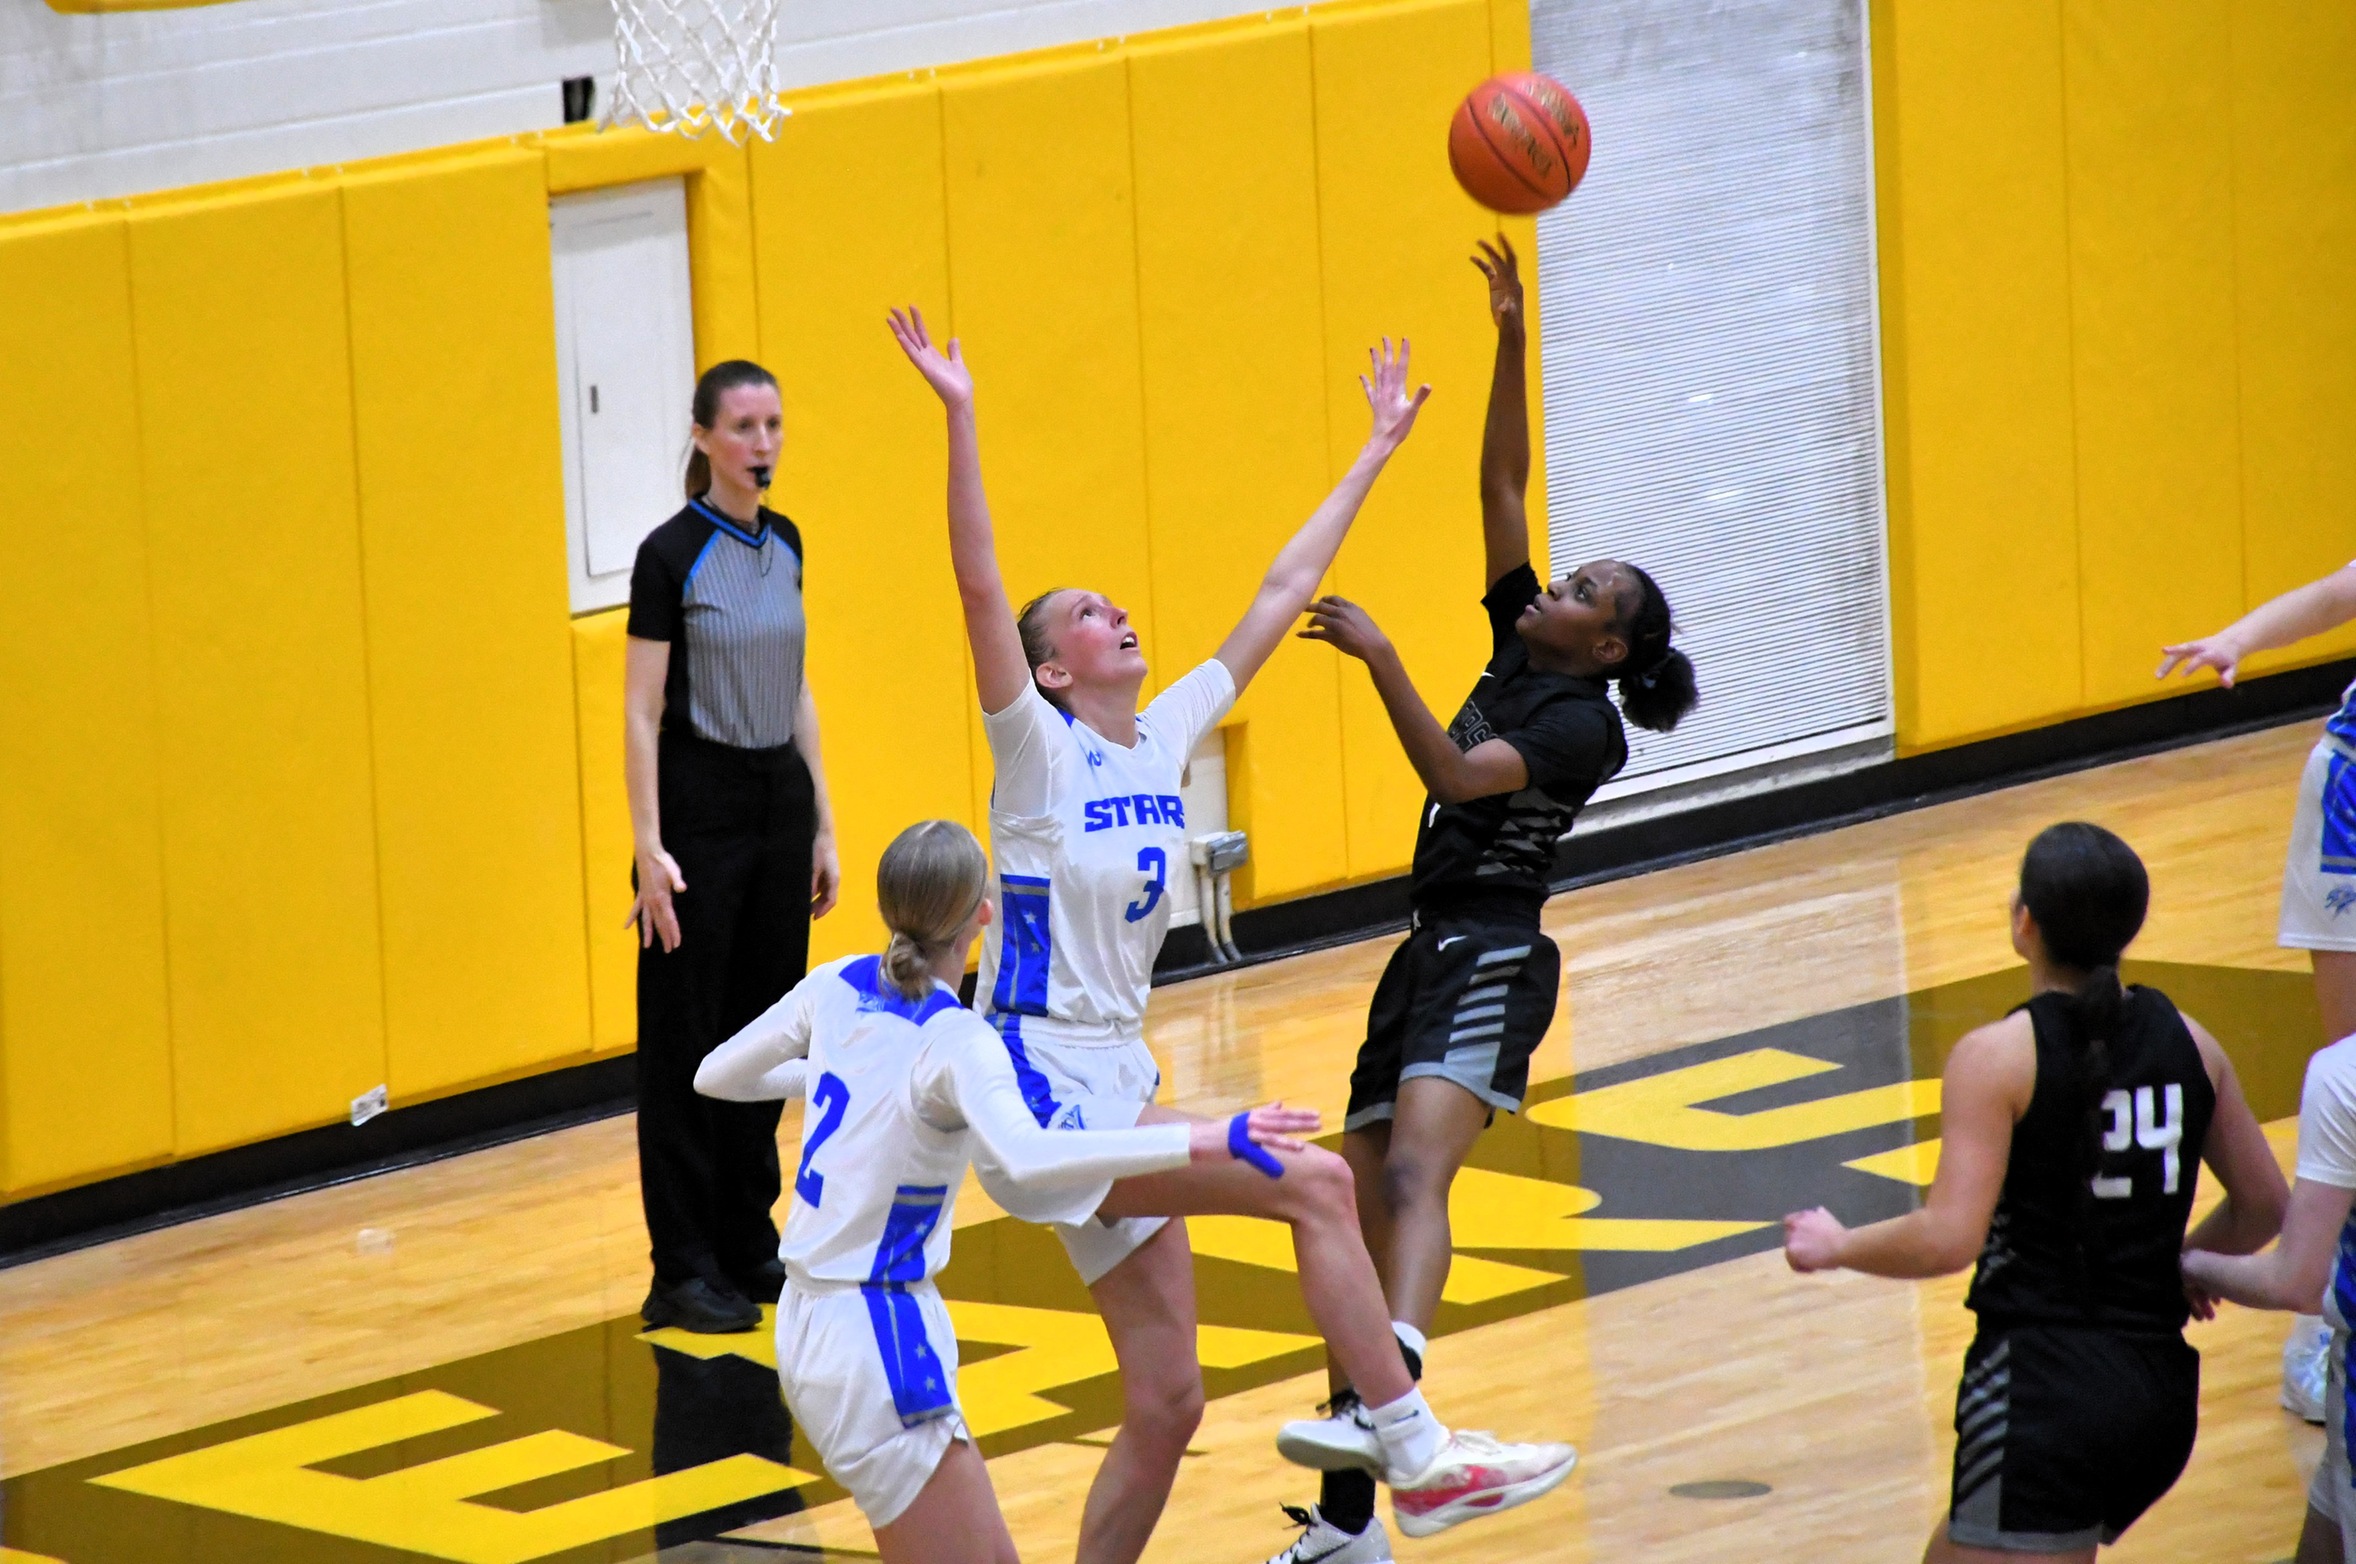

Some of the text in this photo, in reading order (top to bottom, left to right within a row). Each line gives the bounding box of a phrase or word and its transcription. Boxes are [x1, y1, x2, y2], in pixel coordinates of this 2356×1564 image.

[1084, 793, 1185, 833] STAR
[1124, 846, 1166, 923] 3
[795, 1071, 851, 1209] 2
[2091, 1082, 2184, 1199] 24
[0, 1047, 1941, 1564] EARS
